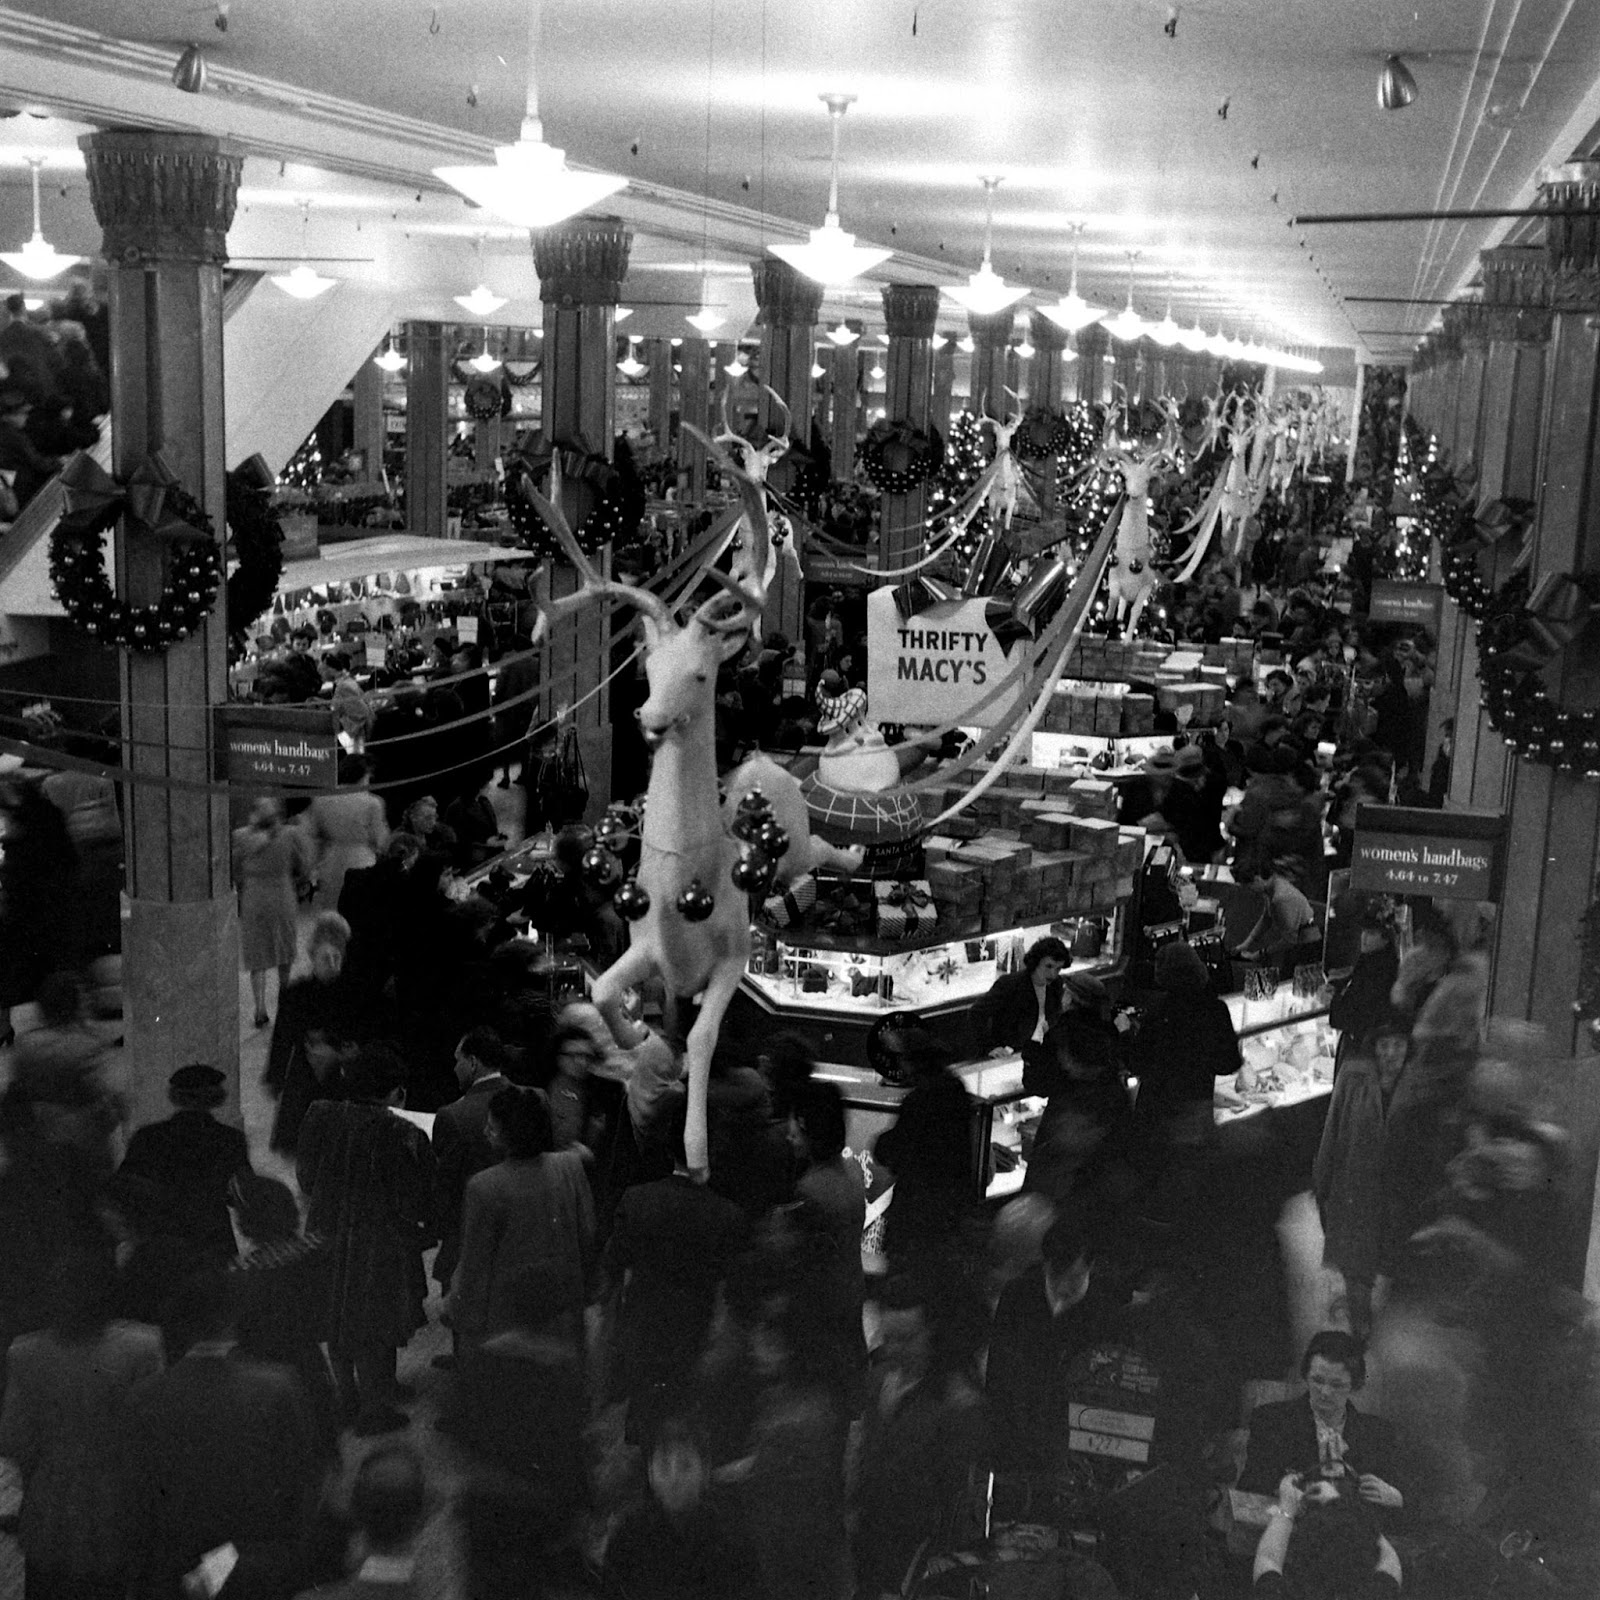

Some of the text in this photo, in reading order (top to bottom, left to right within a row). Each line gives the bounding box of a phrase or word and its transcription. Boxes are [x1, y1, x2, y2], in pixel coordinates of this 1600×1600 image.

[897, 629, 988, 653] THRIFTY
[897, 656, 987, 684] MACY'S
[230, 739, 330, 760] women's handbags
[1361, 846, 1488, 871] women's handbags
